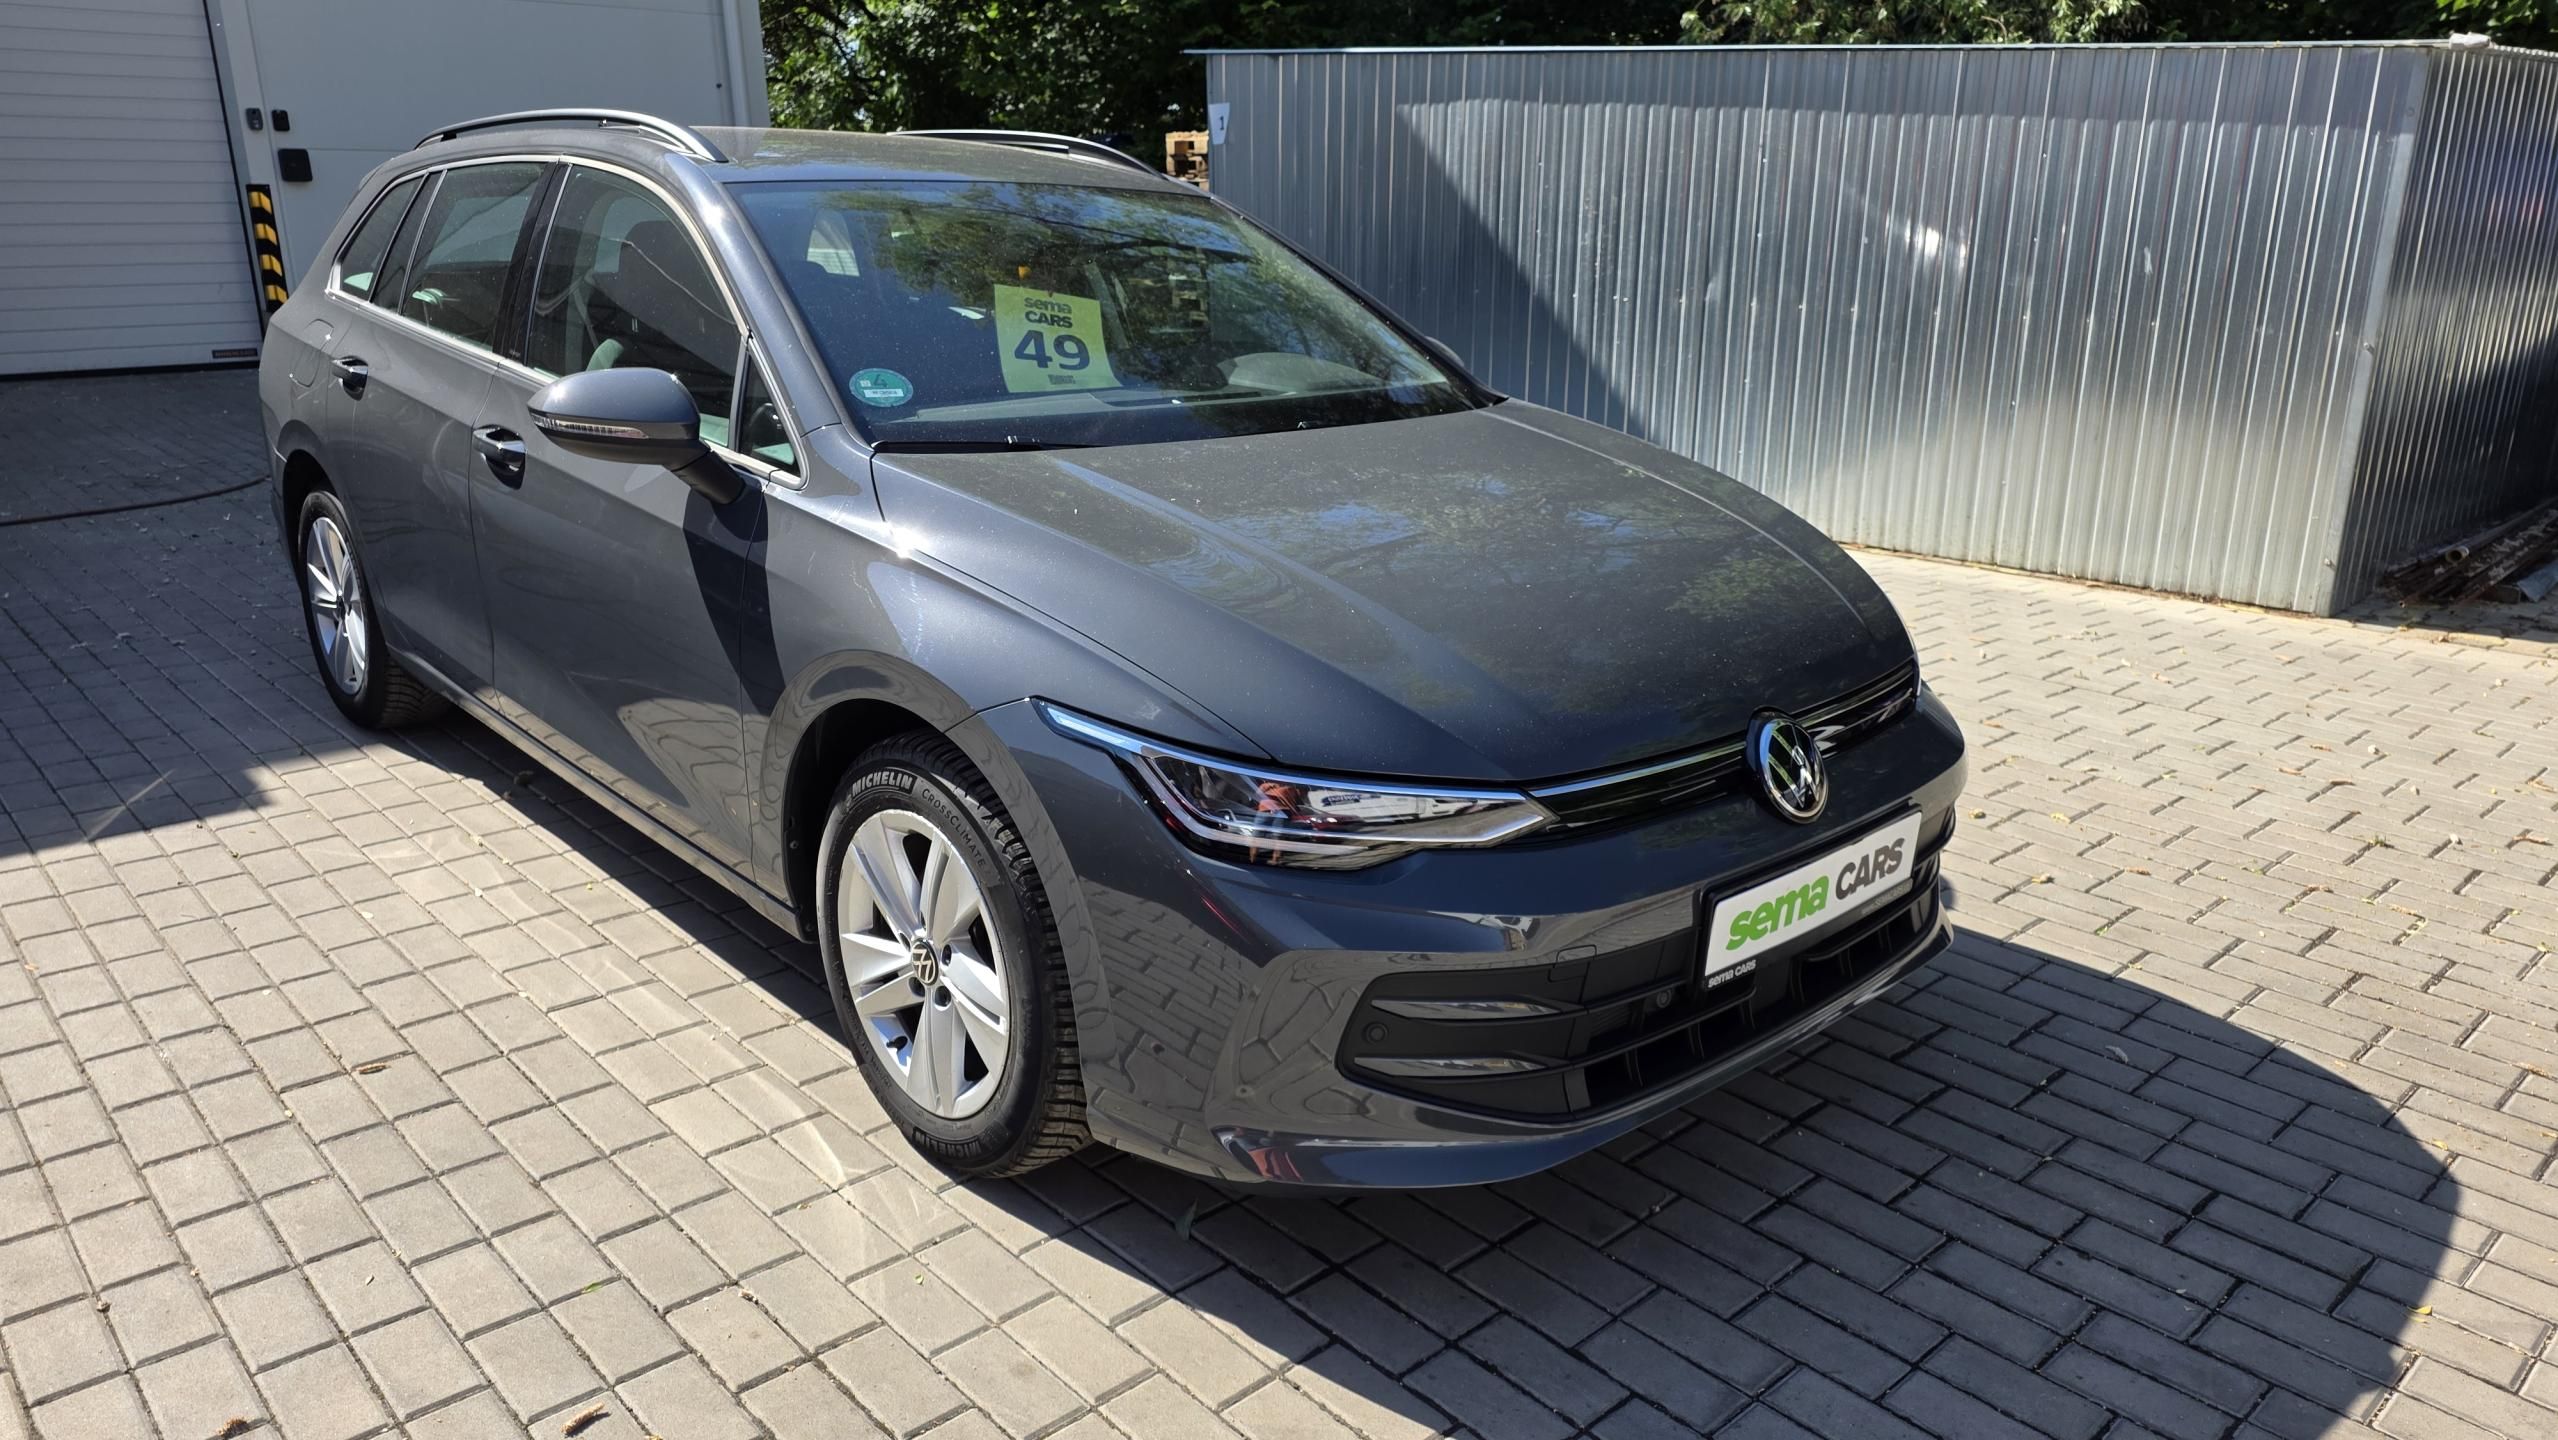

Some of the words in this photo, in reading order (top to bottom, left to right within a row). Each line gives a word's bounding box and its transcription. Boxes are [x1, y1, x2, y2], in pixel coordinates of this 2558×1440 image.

[1023, 296, 1073, 315] sema
[1024, 310, 1073, 329] CARS
[1013, 329, 1091, 371] 49
[851, 769, 914, 798] MICHELIN
[921, 787, 987, 867] CROSSCLIMATE
[1726, 875, 1830, 951] sema
[1835, 837, 1905, 900] CARS
[1734, 959, 1757, 977] CARS
